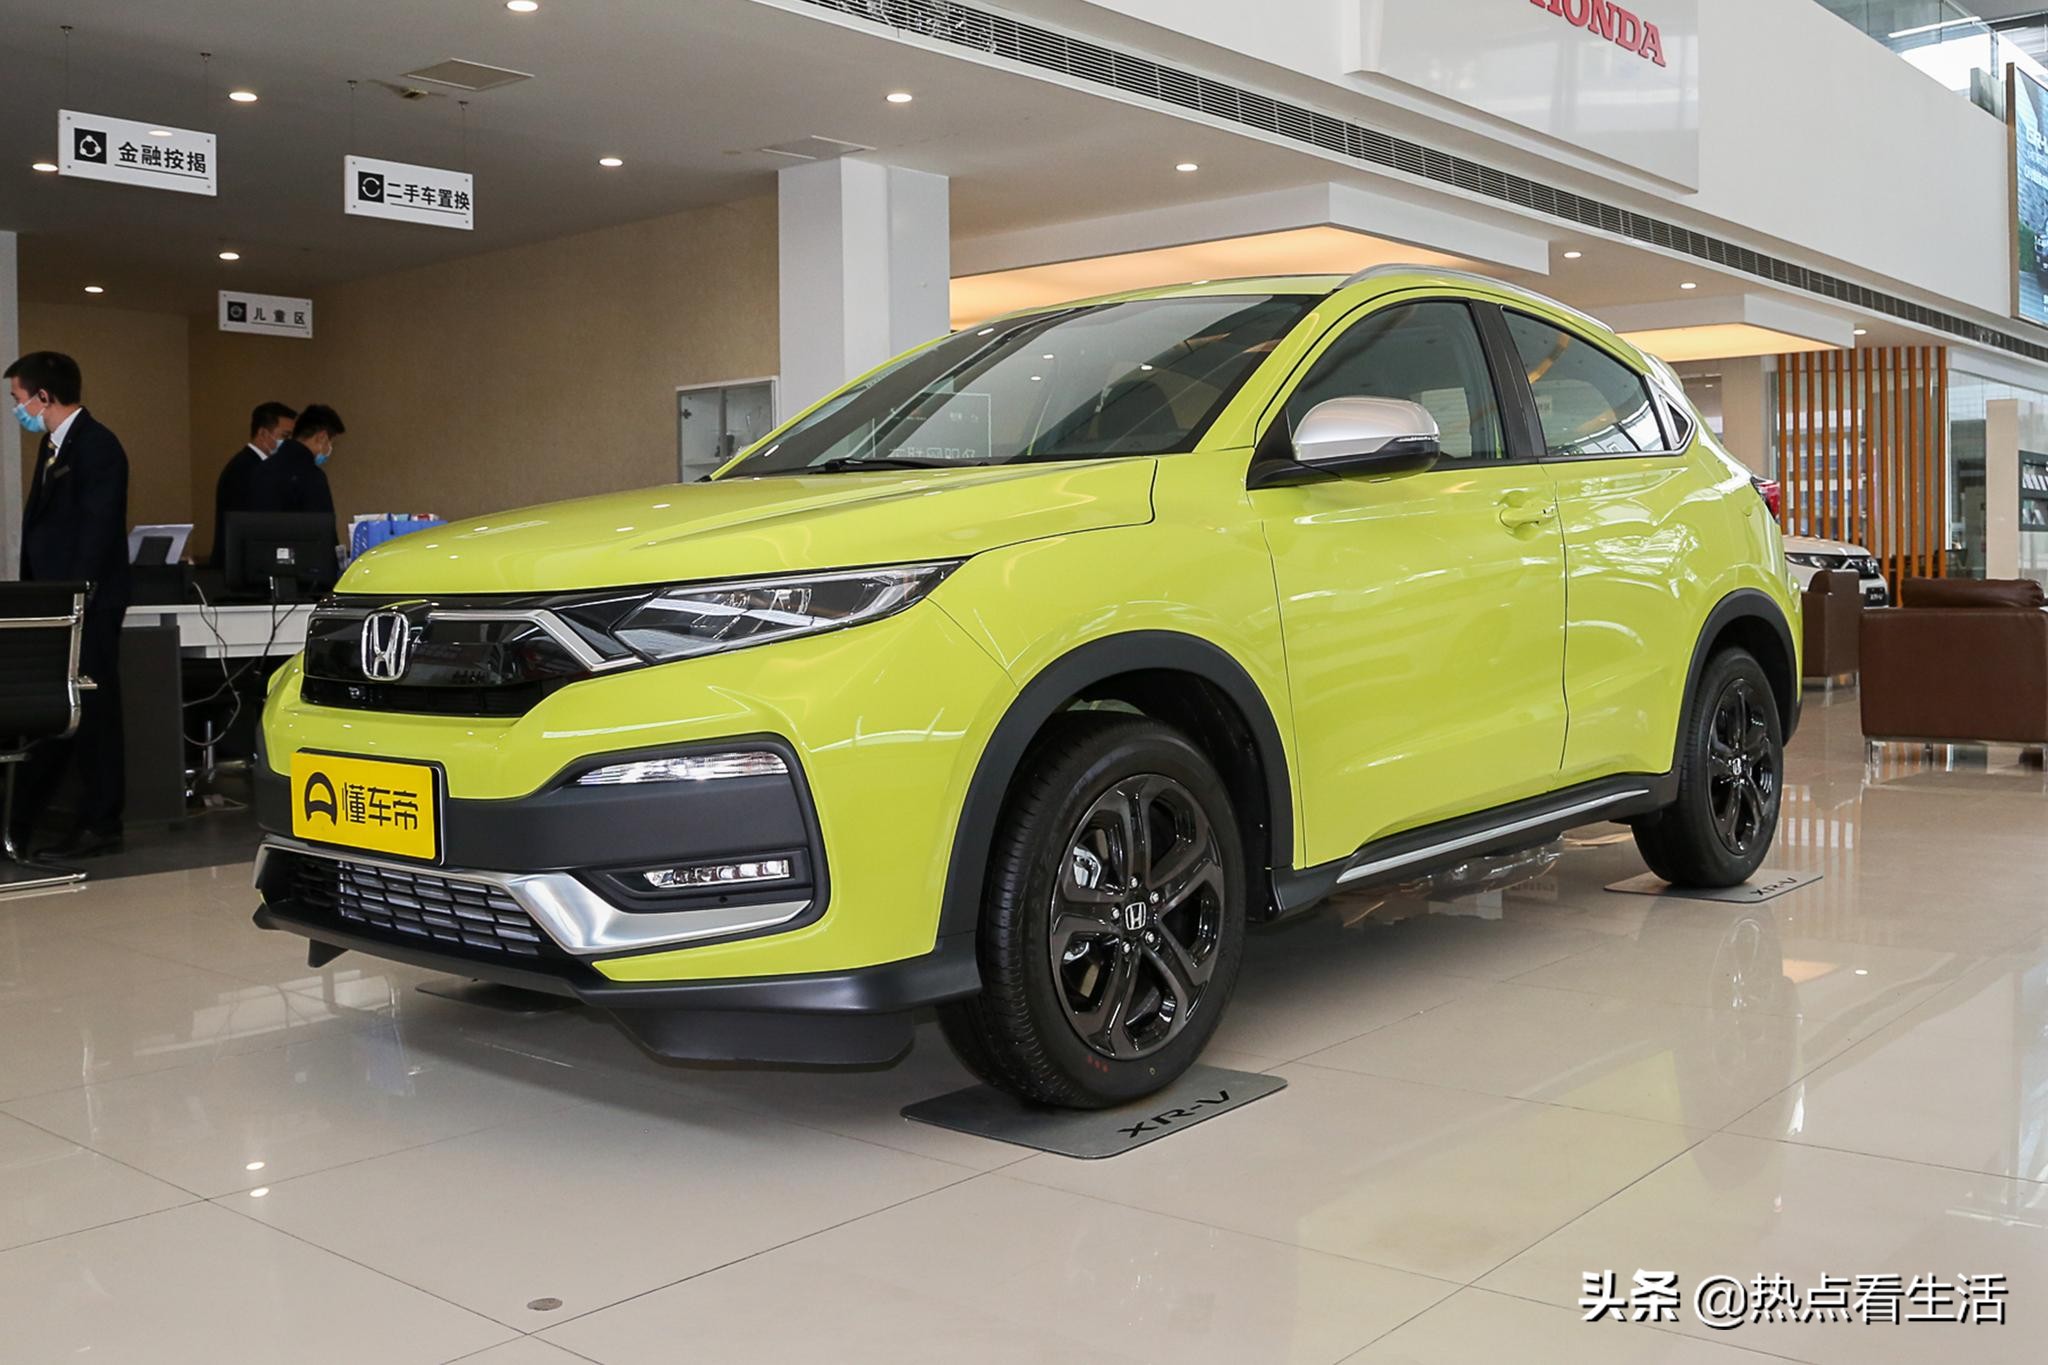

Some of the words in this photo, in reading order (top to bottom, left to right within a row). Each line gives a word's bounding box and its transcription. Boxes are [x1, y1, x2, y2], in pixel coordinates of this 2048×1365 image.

[118, 141, 207, 174] 金融按揭
[386, 182, 470, 211] 二手车置换
[254, 307, 306, 326] 儿童区
[341, 781, 420, 831] 懂车帝
[1116, 1089, 1230, 1138] XR-V
